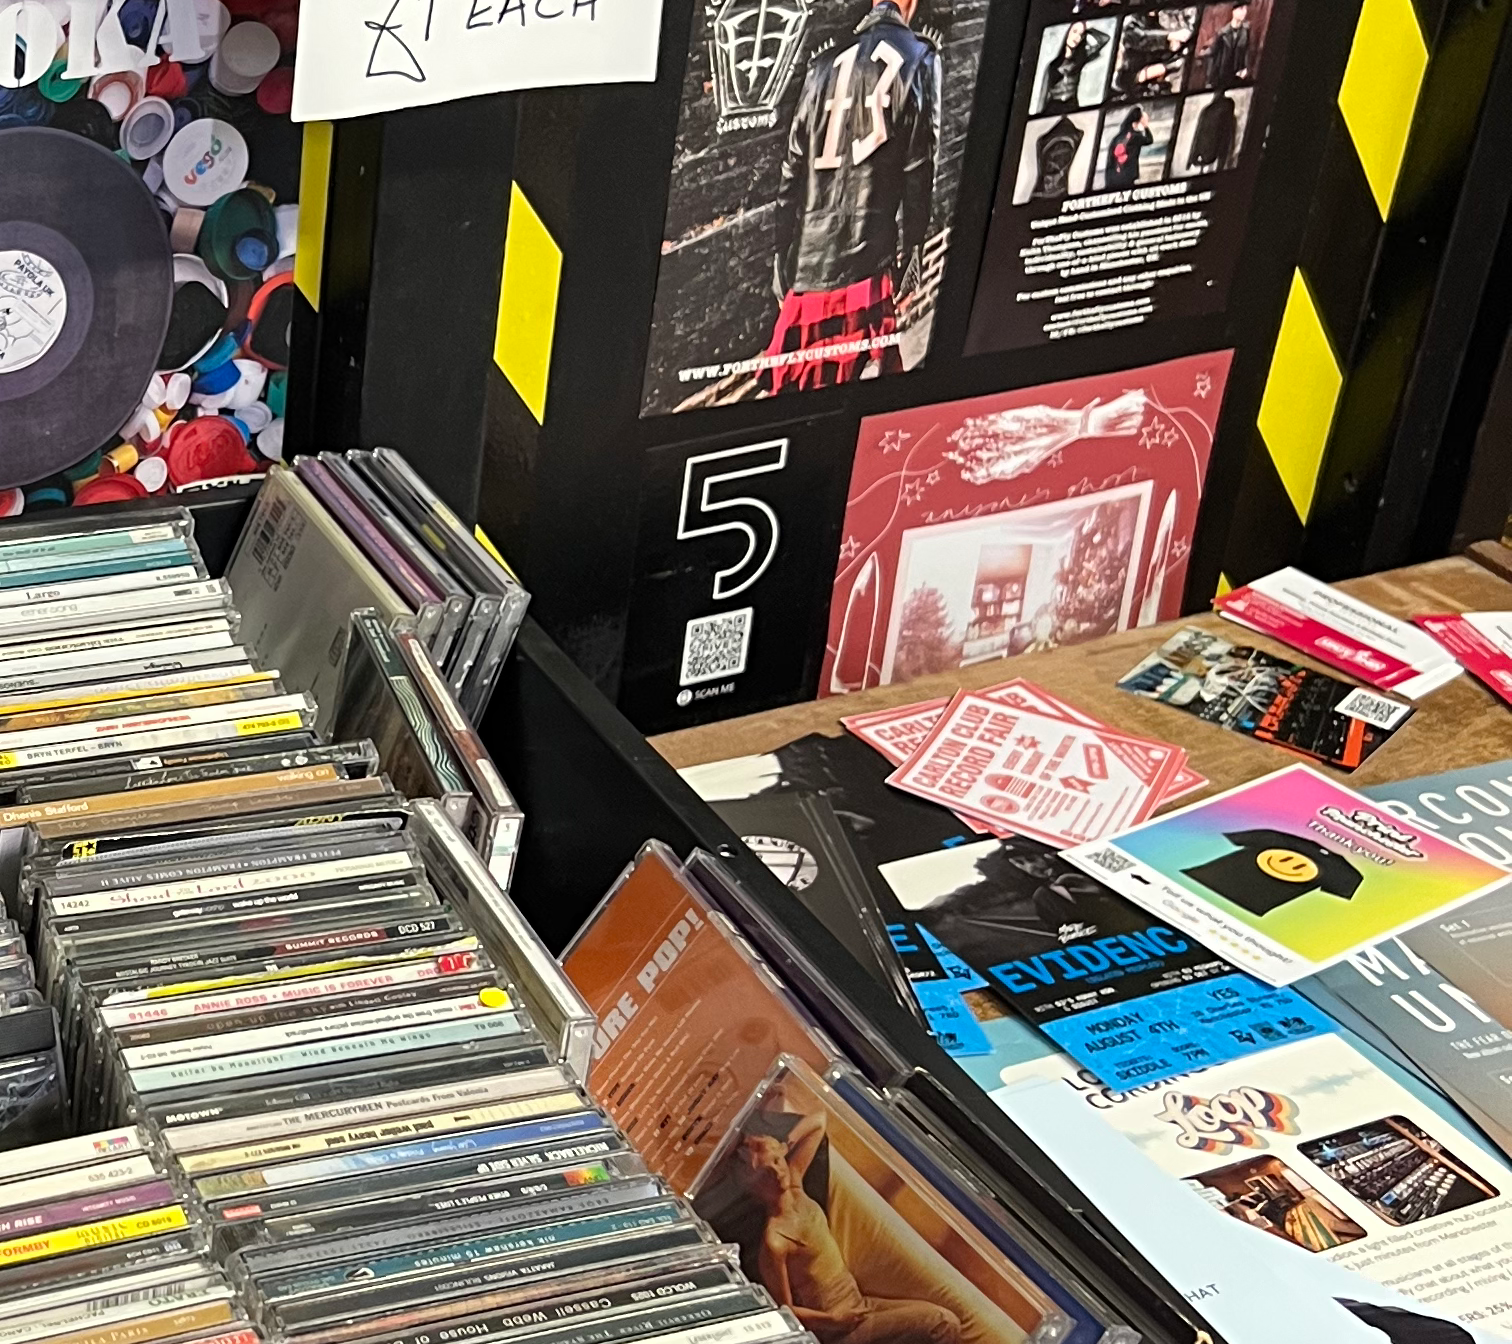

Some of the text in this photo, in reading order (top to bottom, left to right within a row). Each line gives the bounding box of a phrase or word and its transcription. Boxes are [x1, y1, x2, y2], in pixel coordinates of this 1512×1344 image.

[814, 40, 904, 170] 13
[677, 437, 789, 600] 5
[25, 588, 61, 601] Largo
[951, 704, 990, 741] CLUB
[940, 711, 1020, 799] RECORD FAIR
[988, 926, 1188, 994] EVIDENC
[128, 975, 394, 1022] 91446 ANNIE ROSS MUSIC FOREVER
[1086, 1012, 1144, 1036] MONDAY
[1085, 1028, 1142, 1054] AUGUST
[303, 1101, 384, 1122] MERCURYMEN
[14, 1215, 43, 1229] RISE
[654, 1281, 697, 1297] WOLCD
[555, 1296, 612, 1318] Cassell
[440, 1322, 489, 1340] House
[502, 1311, 550, 1328] Webb
